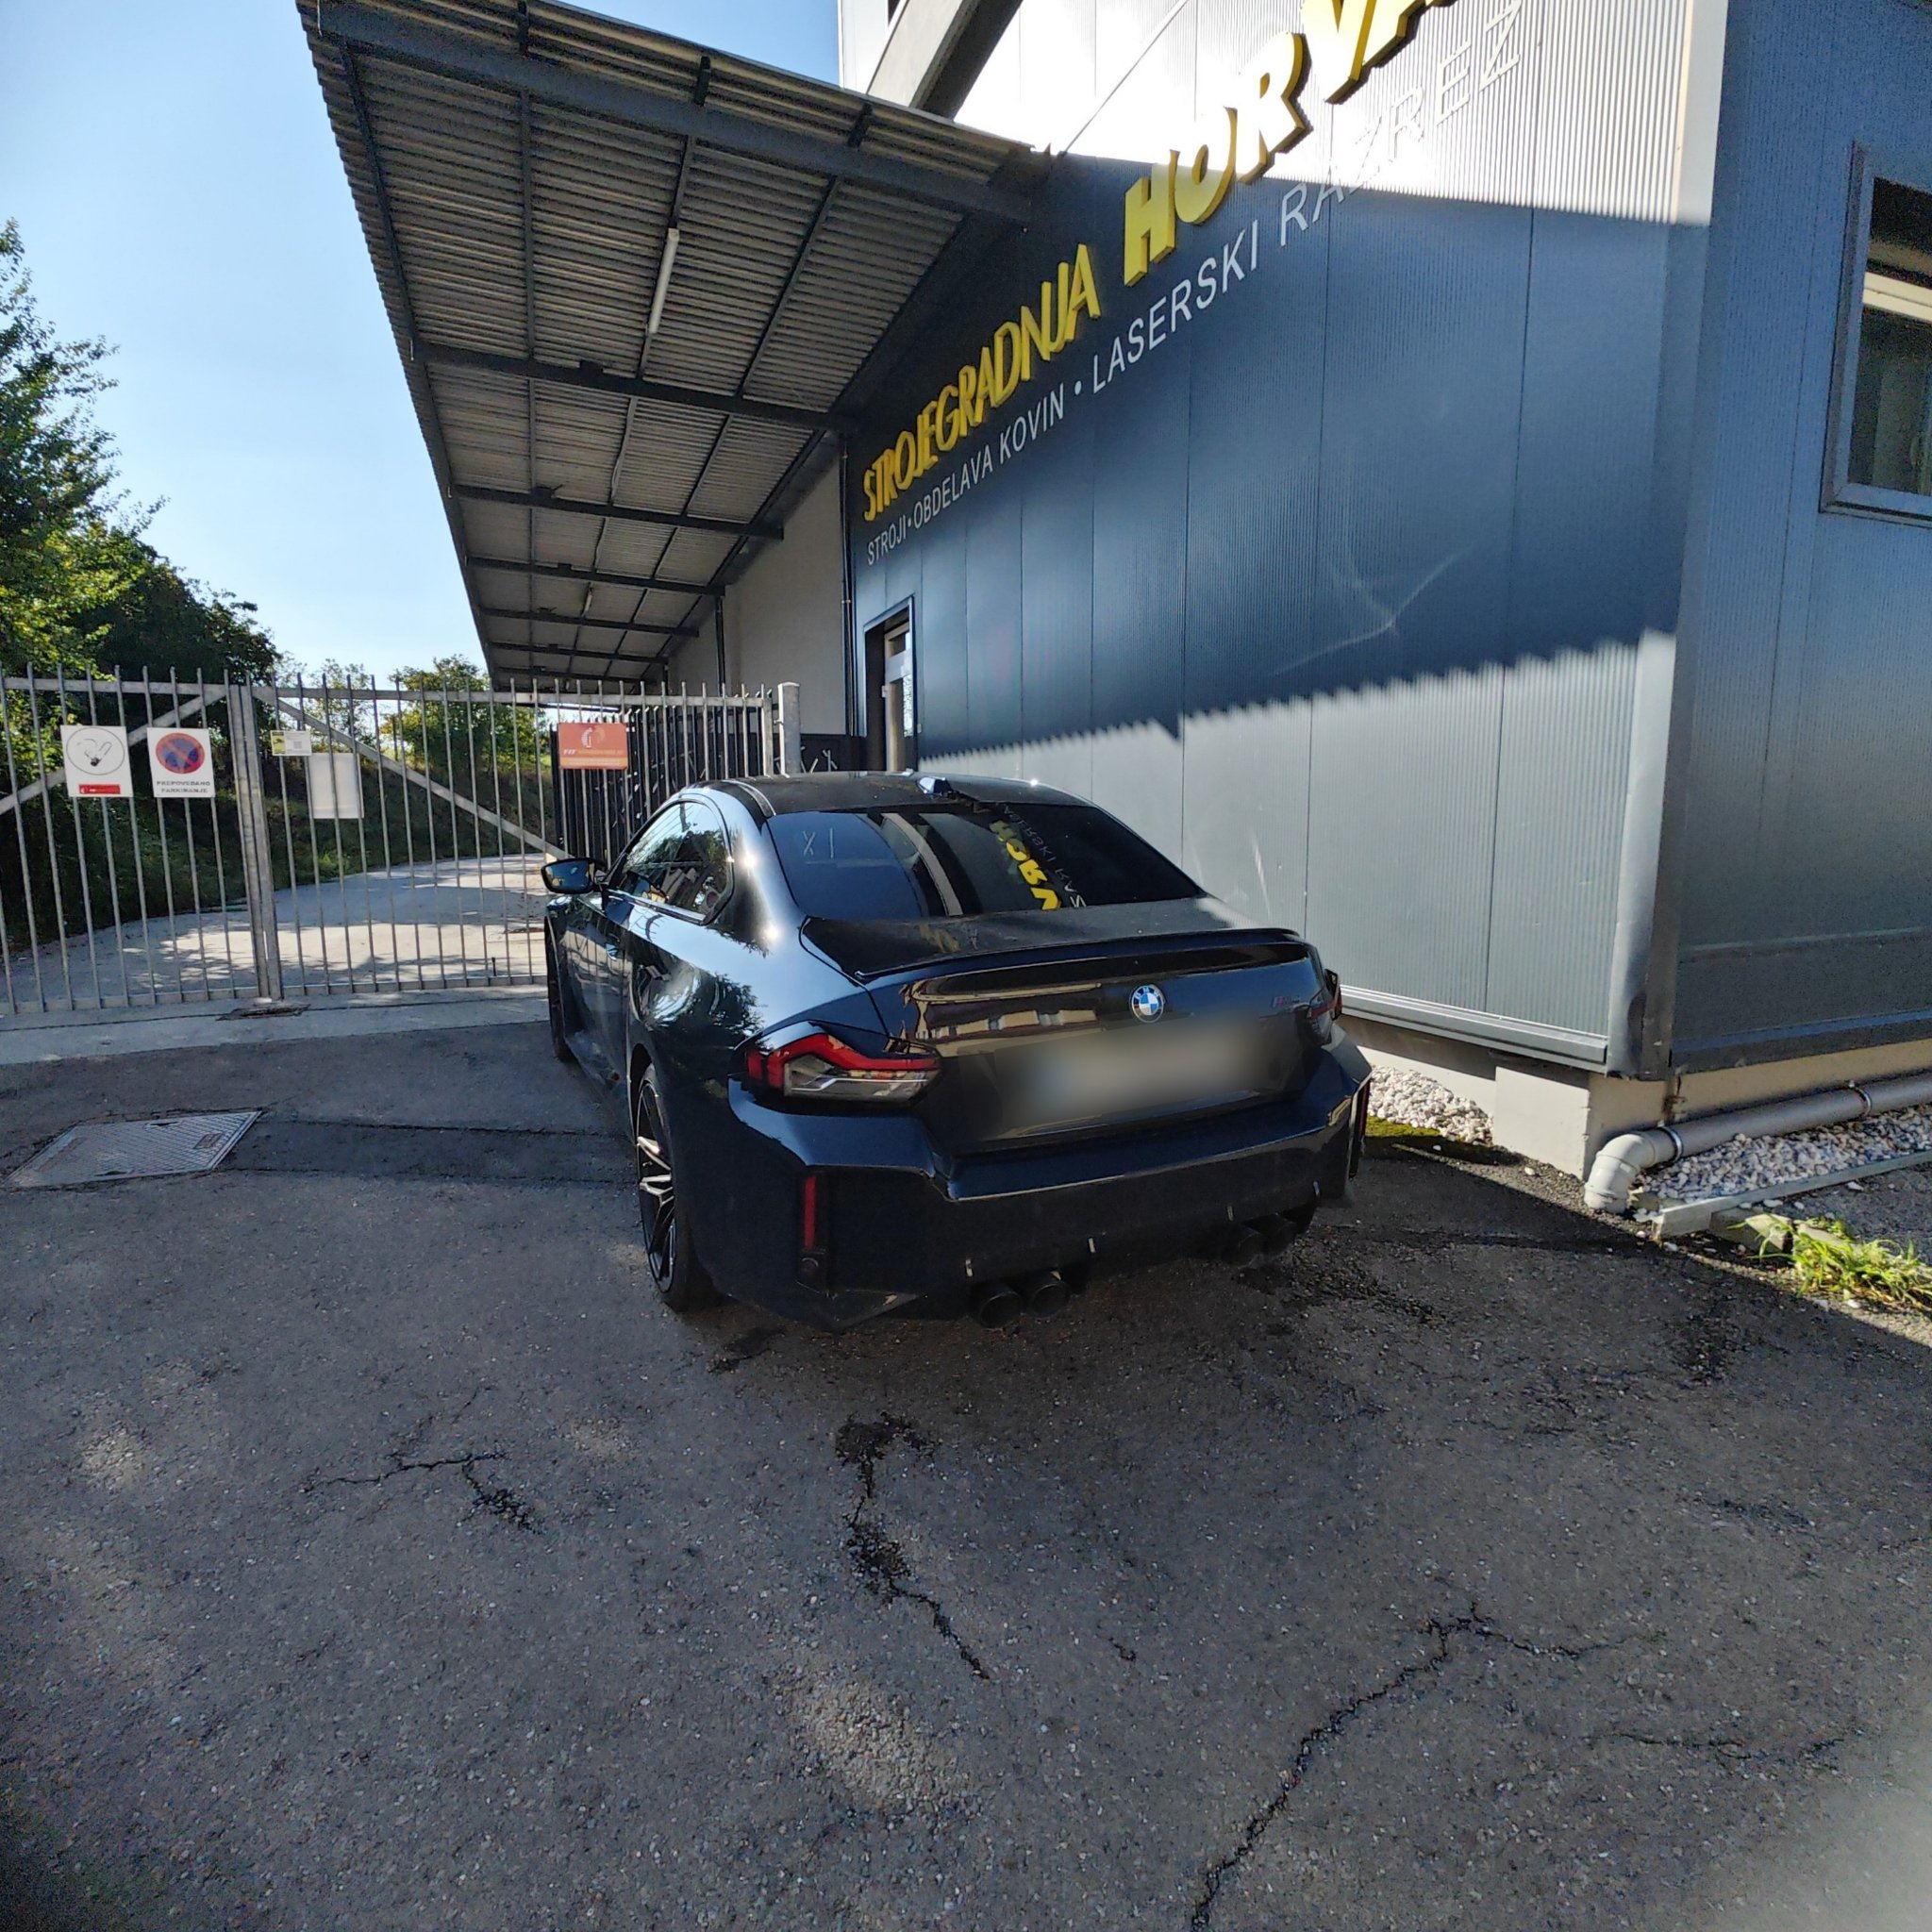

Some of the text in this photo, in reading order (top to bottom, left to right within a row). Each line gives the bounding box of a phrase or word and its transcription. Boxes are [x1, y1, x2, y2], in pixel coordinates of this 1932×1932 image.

[863, 0, 1458, 522] STROJEGRADNJA HORV
[867, 514, 908, 566] STROJI
[913, 444, 993, 529] OBDELAVA
[999, 382, 1065, 464] KOVIN
[1091, 220, 1259, 394] LASERSKI
